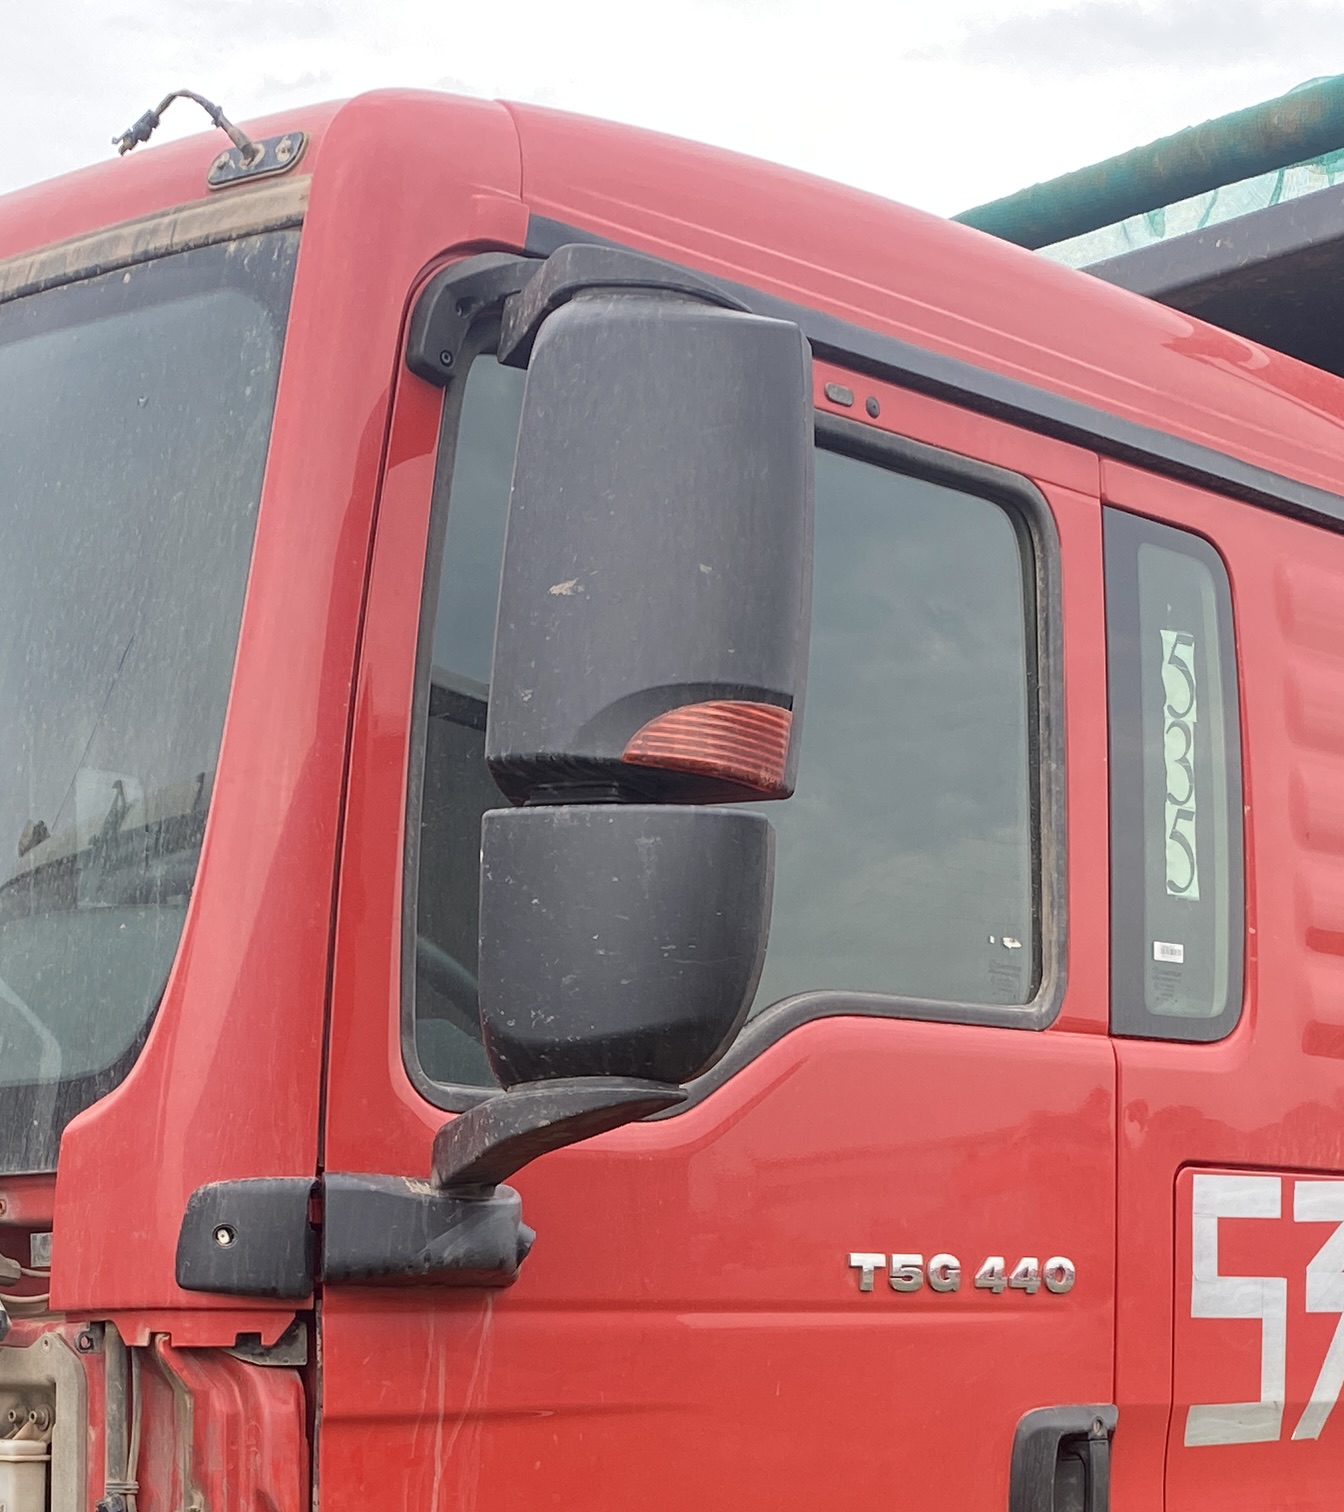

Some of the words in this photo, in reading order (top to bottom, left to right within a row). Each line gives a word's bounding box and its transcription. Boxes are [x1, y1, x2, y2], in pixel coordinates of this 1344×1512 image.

[1167, 633, 1195, 892] 535
[849, 1252, 961, 1292] T5G
[974, 1256, 1076, 1294] 440
